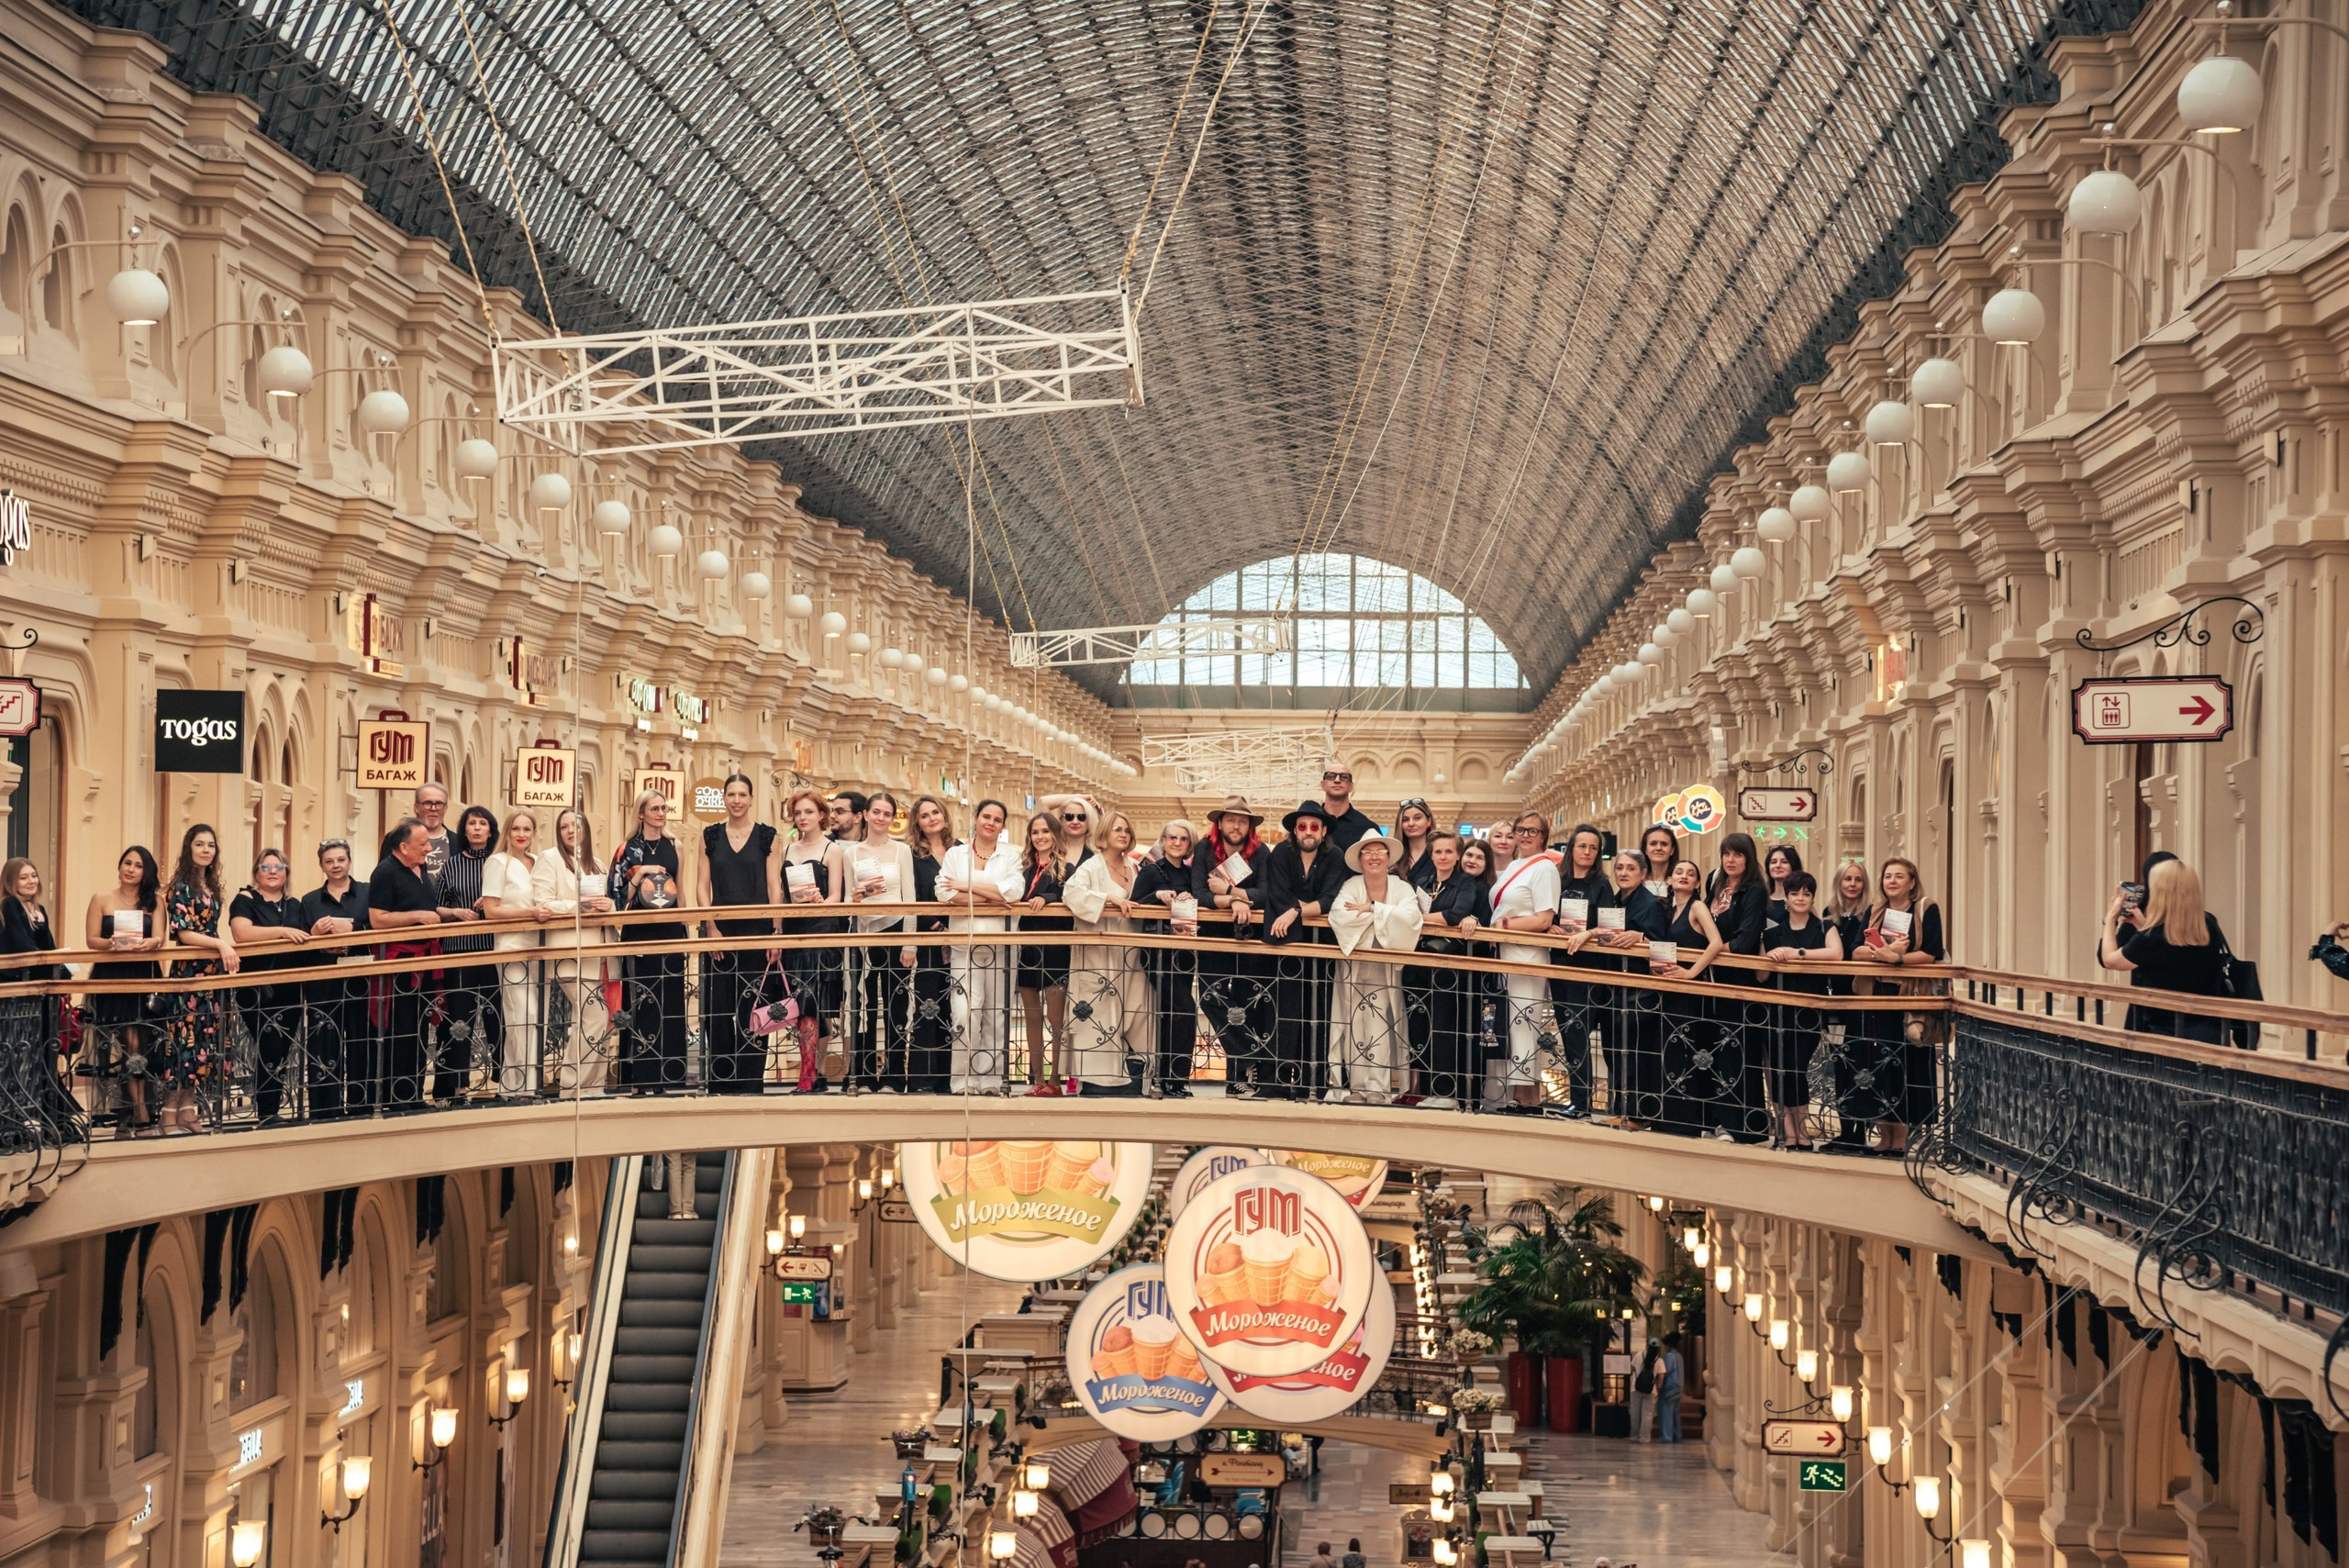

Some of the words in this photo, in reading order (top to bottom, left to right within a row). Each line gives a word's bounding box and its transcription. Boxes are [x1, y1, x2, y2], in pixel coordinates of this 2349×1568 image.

[161, 717, 237, 746] Togas
[370, 729, 415, 765] ГУМ
[366, 769, 417, 781] БАГАЖ
[527, 755, 565, 784] ГУМ
[524, 791, 564, 802] БАГАЖ
[1473, 828, 1491, 840] VT
[1297, 1156, 1370, 1173] Мороженое
[950, 1198, 1102, 1231] Мороженое
[1235, 1187, 1301, 1237] ГУМ
[1205, 1309, 1331, 1337] Мороженое
[1097, 1382, 1206, 1407] Мороженое
